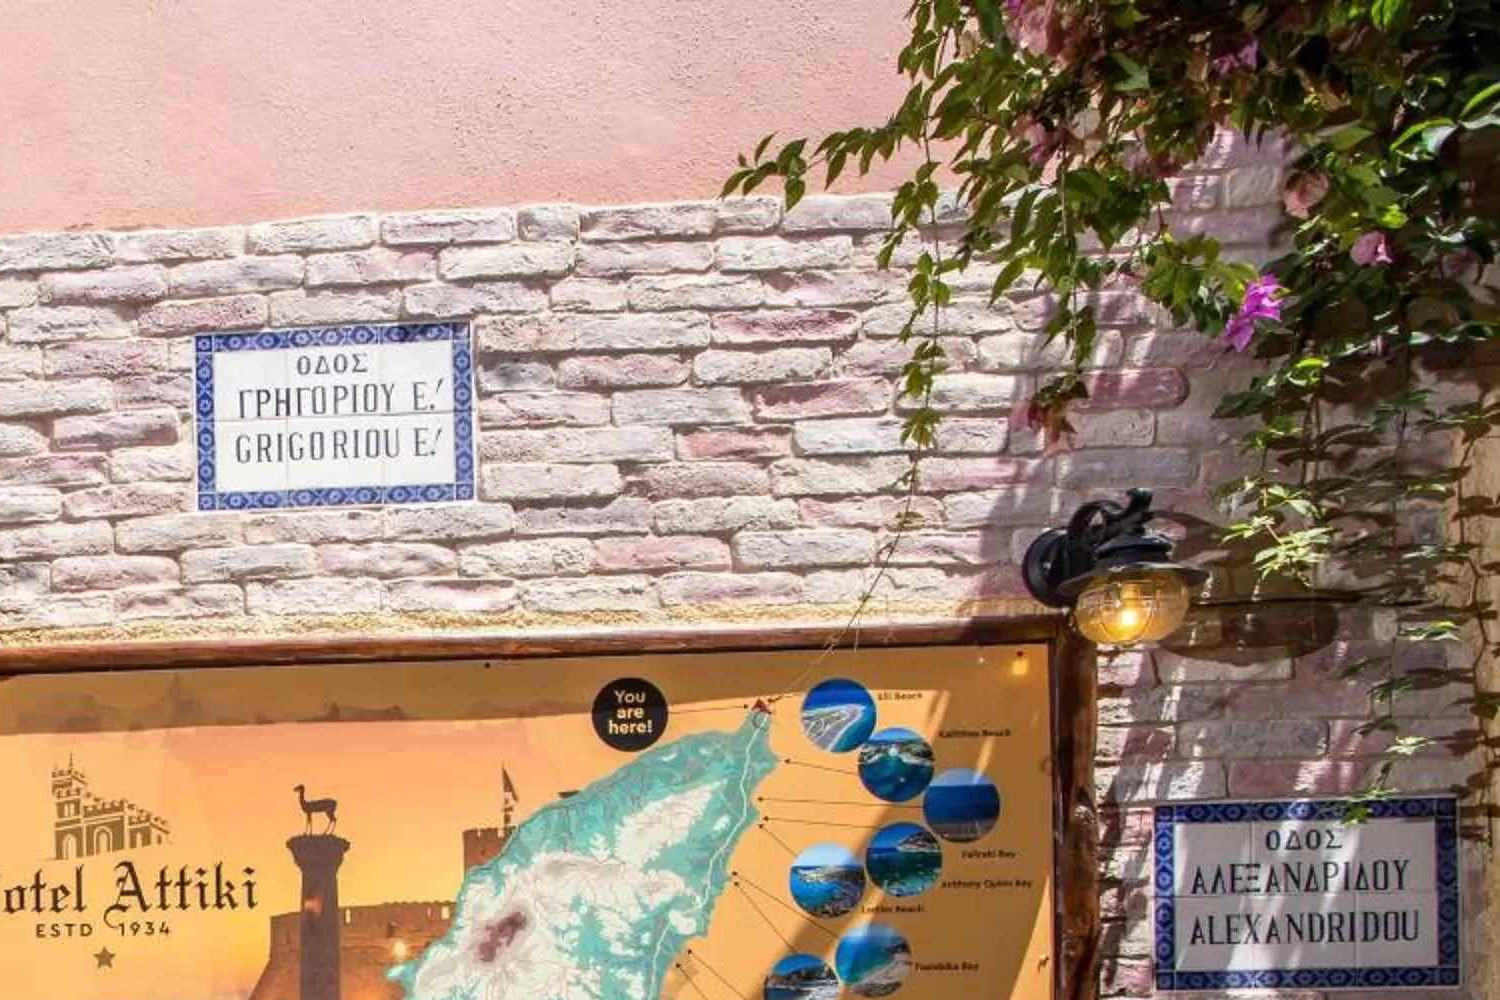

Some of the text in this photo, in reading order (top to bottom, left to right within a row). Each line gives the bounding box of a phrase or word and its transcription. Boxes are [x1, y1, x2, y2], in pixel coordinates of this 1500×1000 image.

[296, 352, 368, 375] ΟΔΟΣ
[238, 383, 395, 418] ΓΡΗΓΟΡΙΟΥ
[235, 427, 400, 463] GRIGORIOU
[613, 689, 646, 703] You
[616, 707, 645, 719] are
[608, 719, 653, 734] here!
[1265, 828, 1343, 850] ΟΔΟΣ
[1191, 859, 1410, 894] ΑΛΕΞΑΝΔΡΙΔΟΥ
[103, 860, 258, 929] Attiki
[35, 921, 171, 938] ESTD 1934
[1190, 910, 1419, 945] ALEXANDRIDOU
